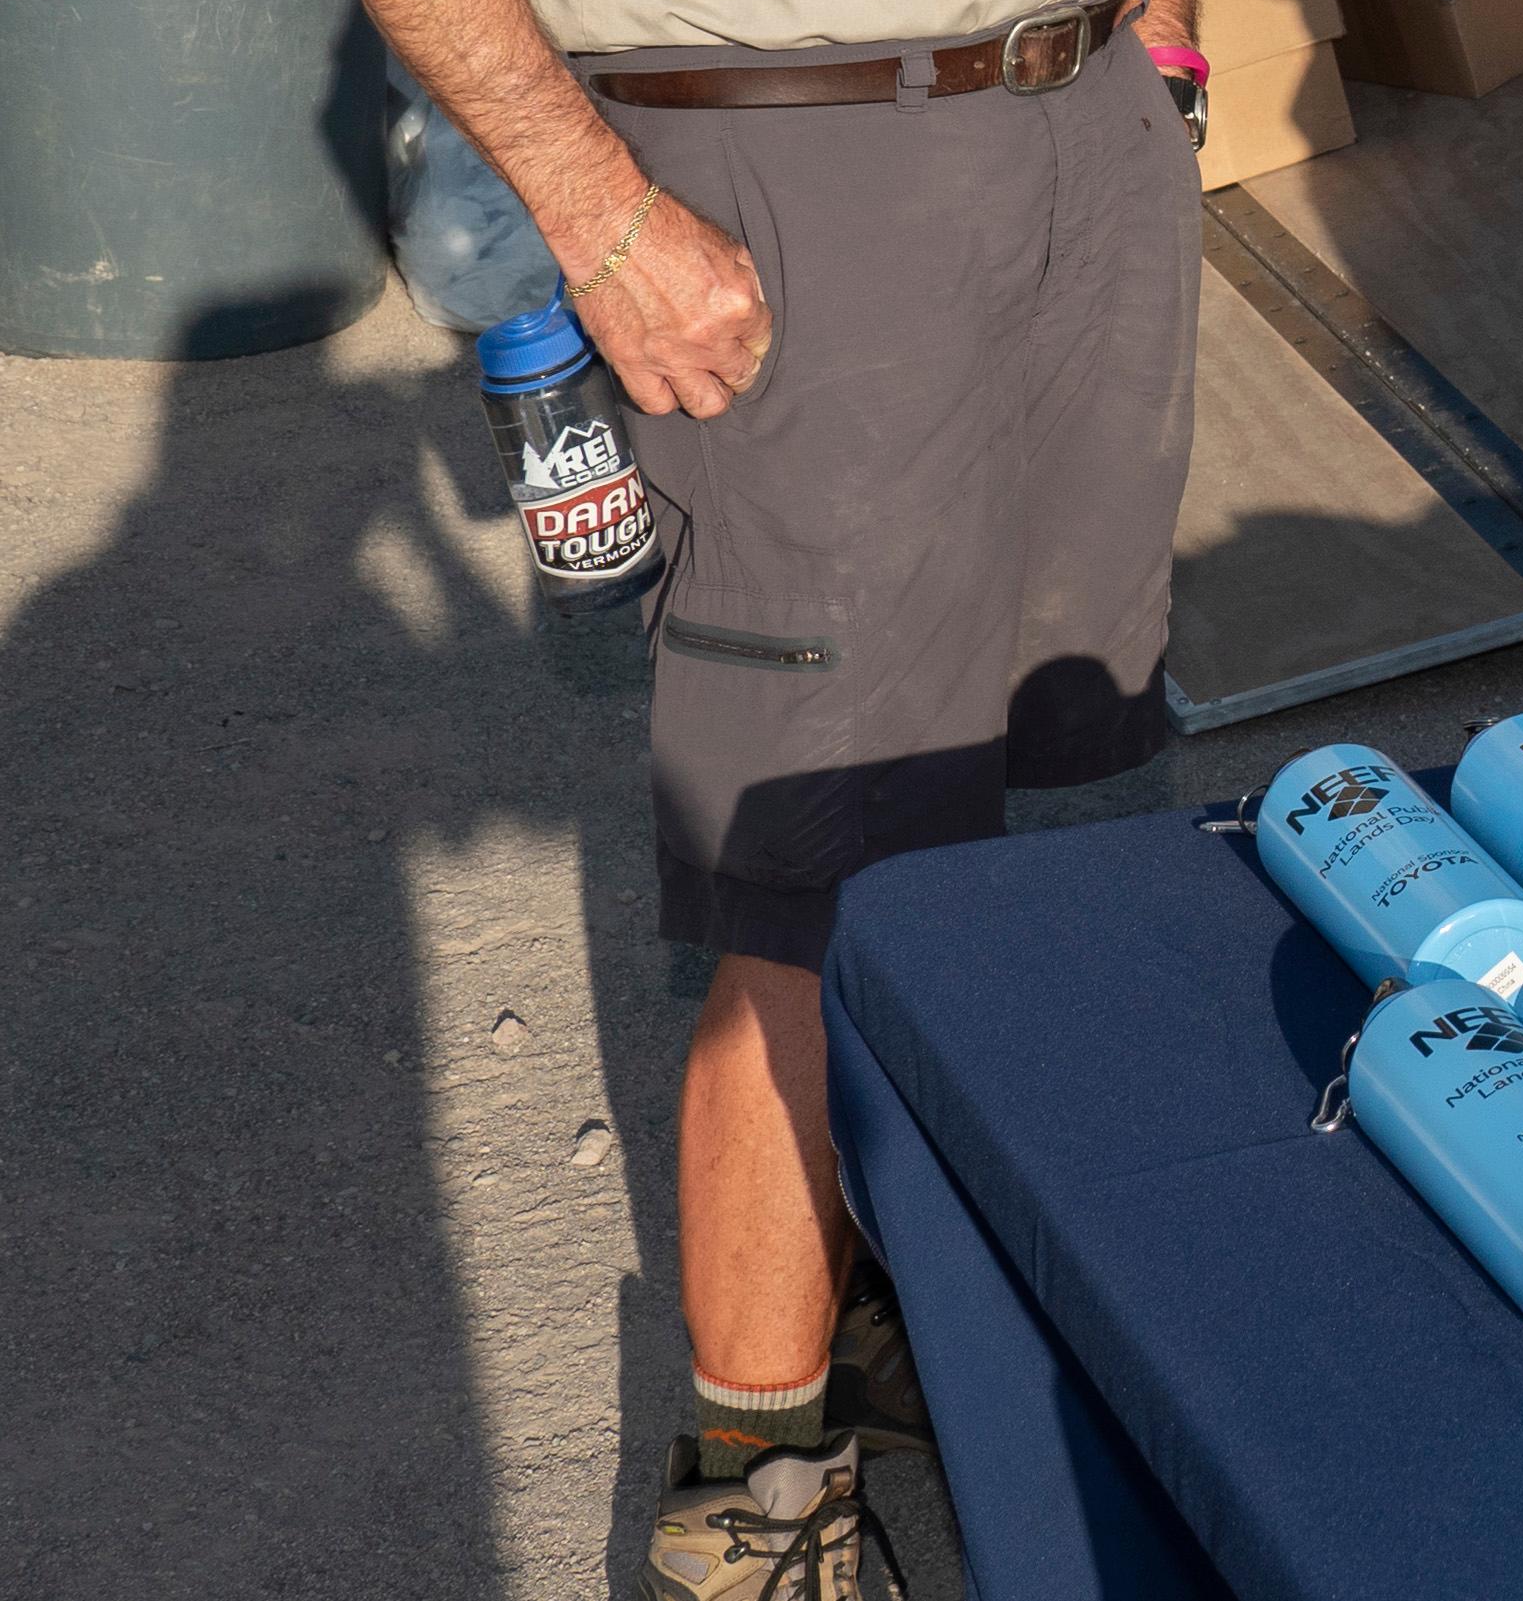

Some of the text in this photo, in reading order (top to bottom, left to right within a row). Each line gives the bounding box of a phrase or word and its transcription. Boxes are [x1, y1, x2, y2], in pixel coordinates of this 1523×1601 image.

[557, 428, 617, 475] REI
[537, 476, 645, 537] DARN
[540, 502, 651, 561] TOUGH
[569, 533, 648, 569] VERMONT
[1286, 765, 1396, 836] NEEF
[1320, 812, 1386, 879] National
[1340, 815, 1435, 867] Lands Day
[1371, 863, 1416, 902] National
[1376, 855, 1480, 909] TOYOTA
[1409, 1006, 1518, 1058] NEE
